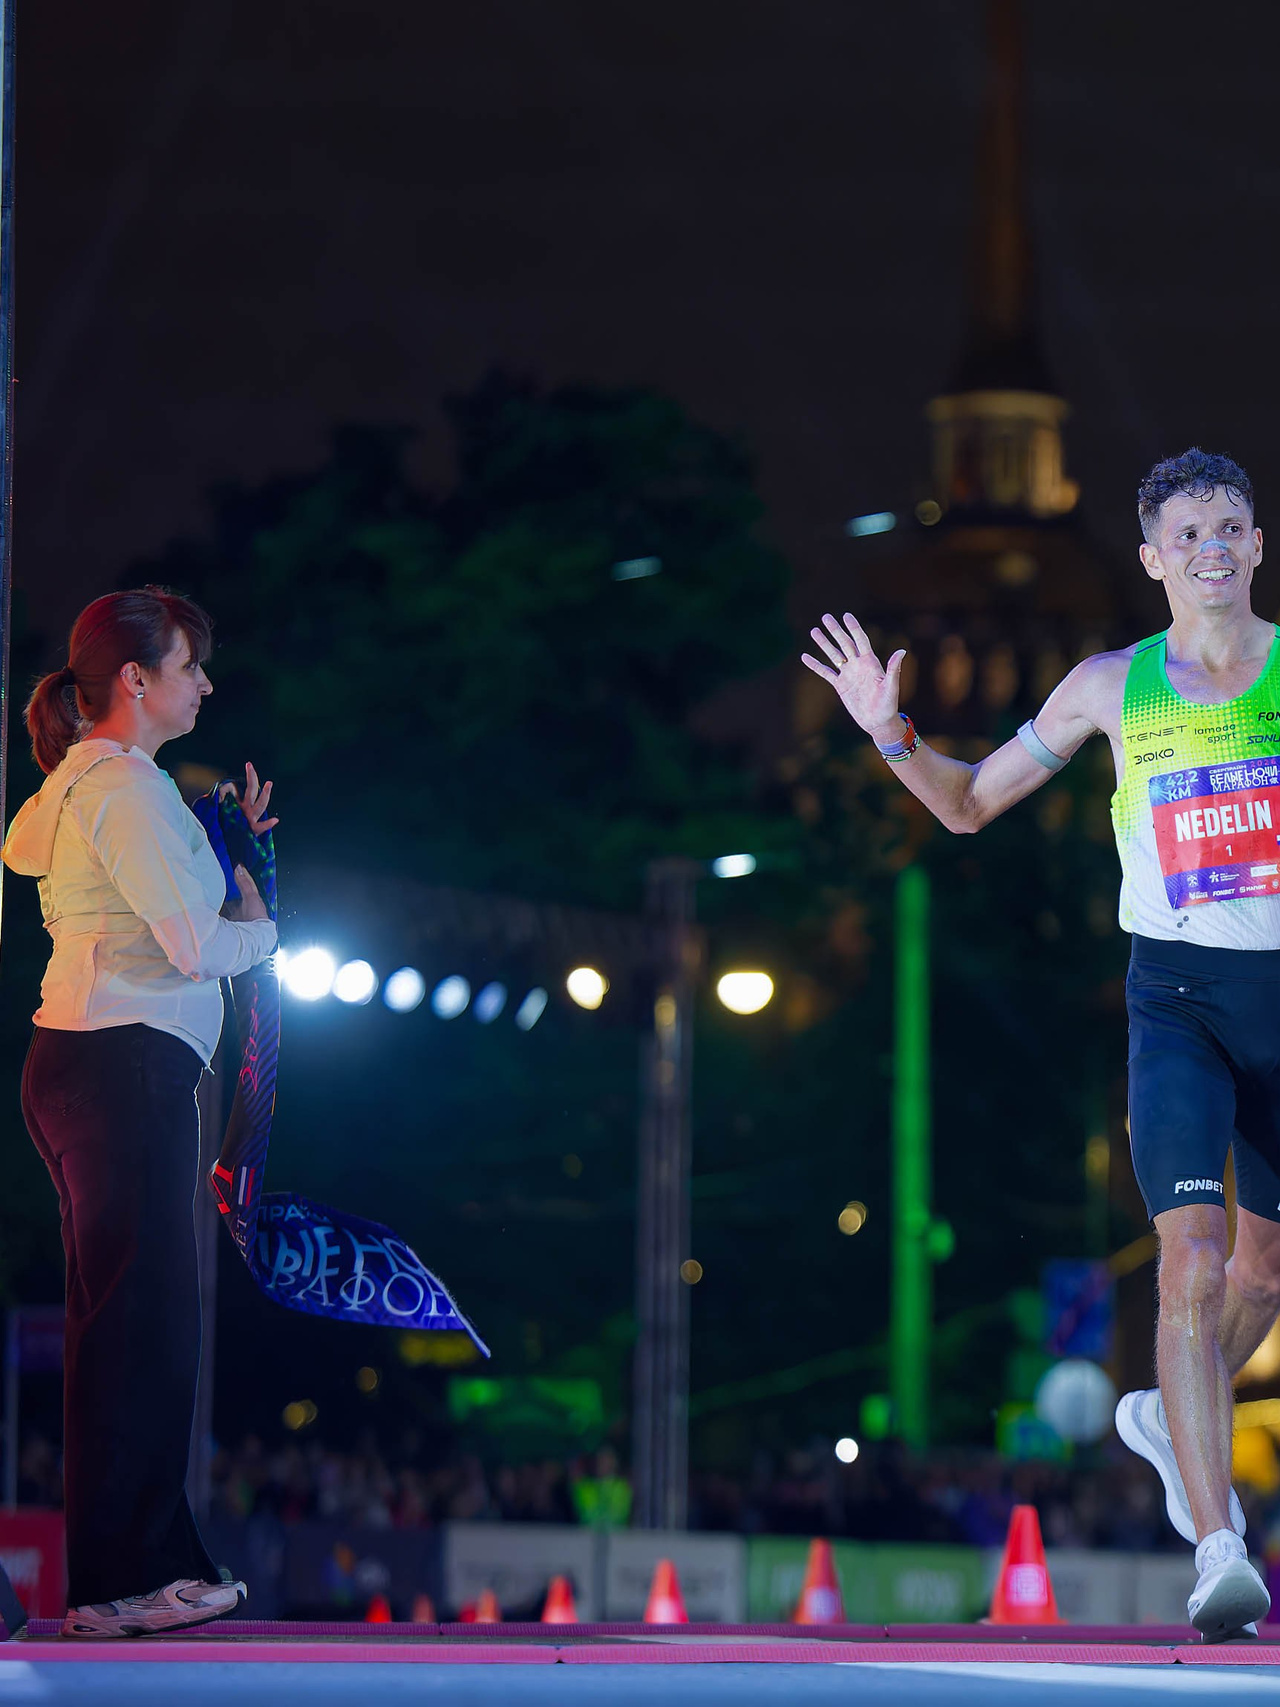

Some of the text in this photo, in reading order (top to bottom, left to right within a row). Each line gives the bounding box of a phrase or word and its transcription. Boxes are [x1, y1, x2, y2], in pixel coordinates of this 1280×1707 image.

[1126, 724, 1188, 743] TENET
[1194, 723, 1236, 735] lamoda
[1207, 731, 1237, 744] sport
[1166, 770, 1199, 787] 42,2
[1209, 765, 1278, 785] БЕЛЫЕ НОЧИ
[1212, 776, 1269, 793] МАРАФОН
[1174, 799, 1273, 843] NEDELIN
[1225, 844, 1233, 857] 1
[1174, 1179, 1224, 1194] FONBET
